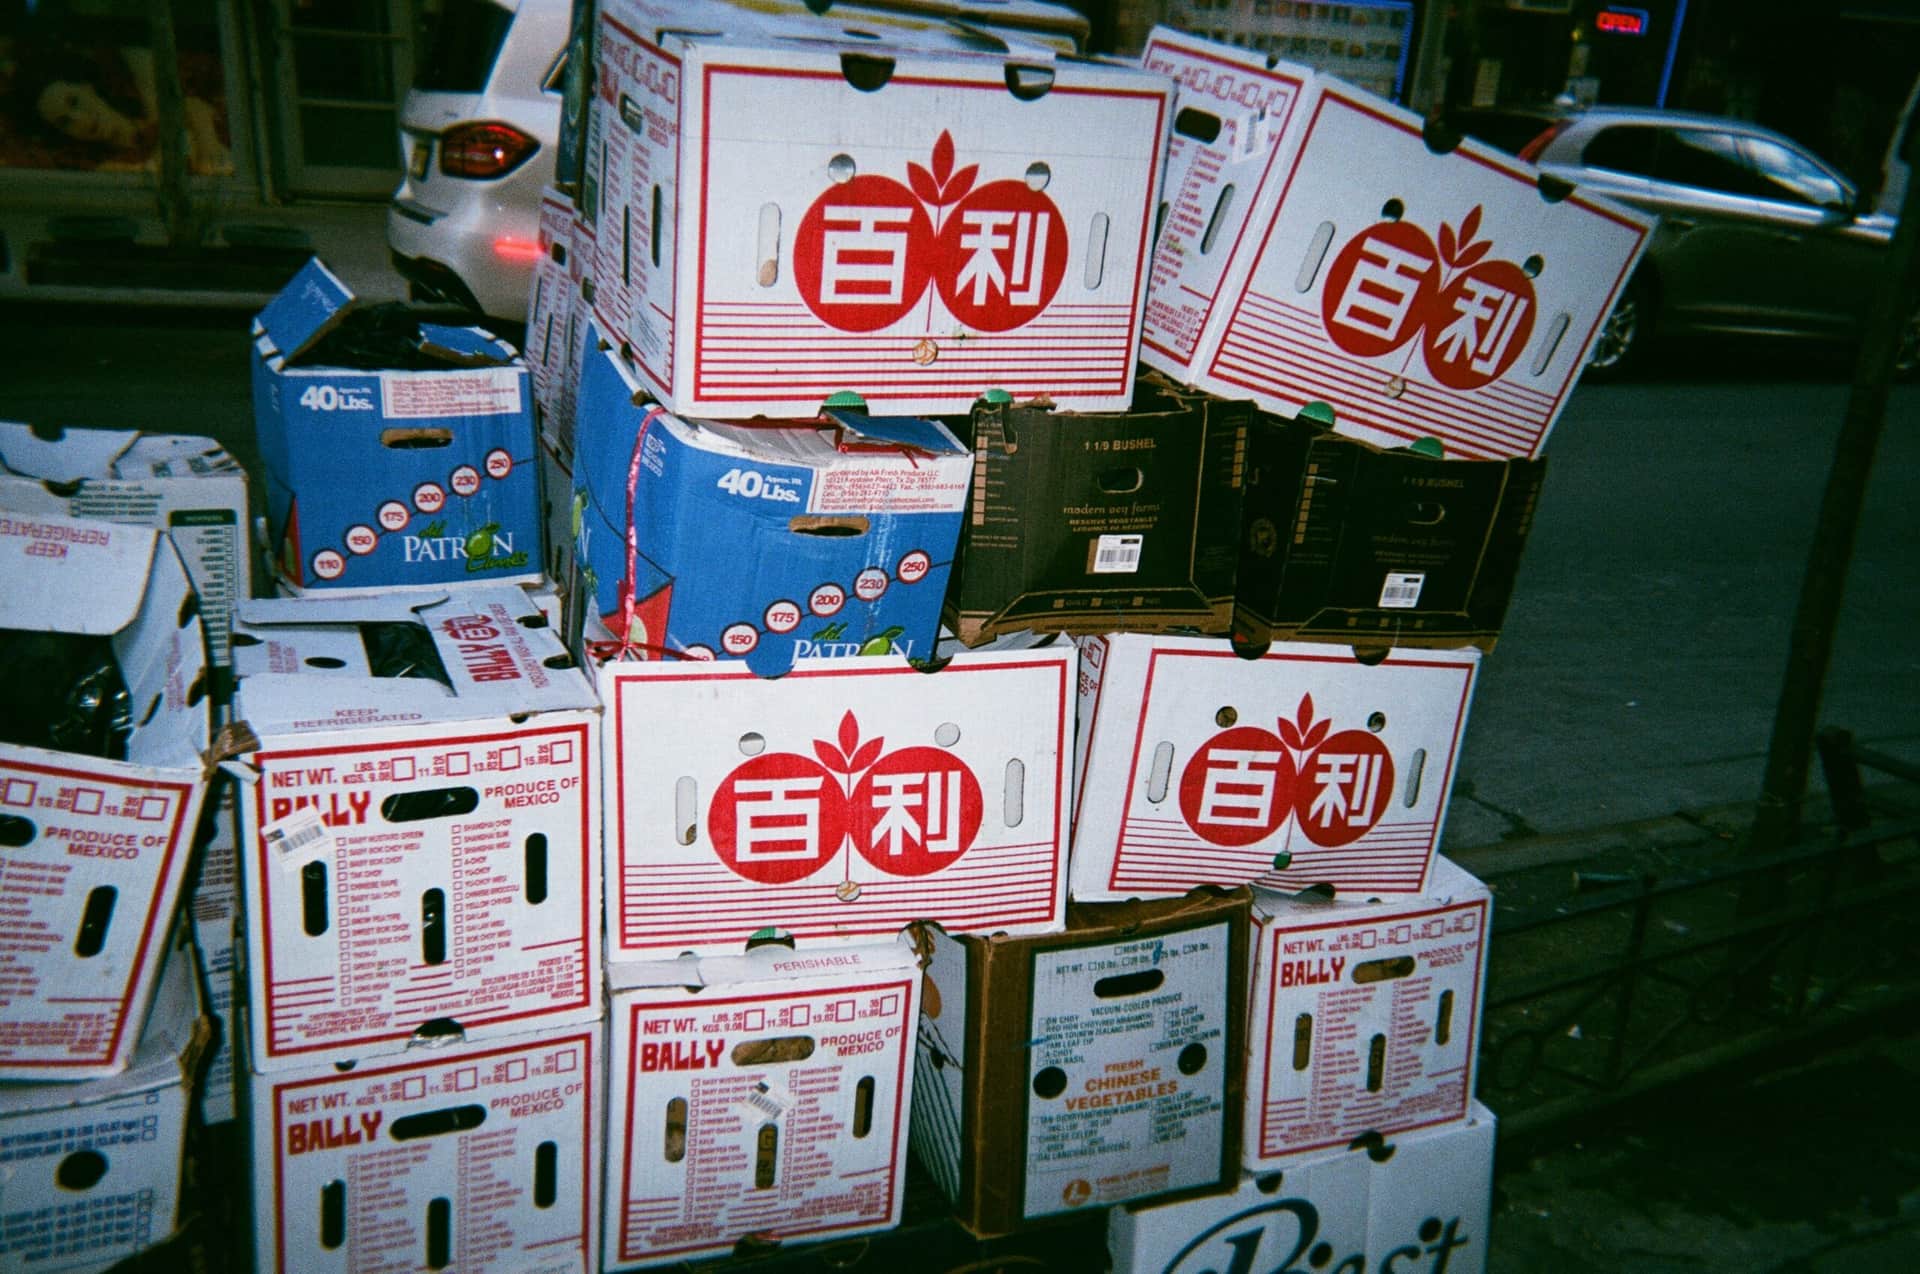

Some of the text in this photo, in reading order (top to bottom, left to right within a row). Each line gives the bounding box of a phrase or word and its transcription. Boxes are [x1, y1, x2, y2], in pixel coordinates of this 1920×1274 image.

[1596, 12, 1640, 31] OPEN
[820, 206, 1048, 307] 百利
[1348, 236, 1530, 374] 百利
[300, 385, 338, 411] 40
[338, 395, 374, 410] Lbs.
[1112, 437, 1157, 451] BUSHEL
[490, 460, 507, 469] 250
[456, 476, 476, 486] 230
[717, 468, 800, 502] 40 Lbs.
[418, 493, 440, 502] 200
[383, 512, 404, 522] 175
[1064, 504, 1105, 514] modern
[1132, 503, 1160, 516] farms
[1070, 516, 1158, 526] RESERVE VEGETABLES
[351, 536, 371, 545] 150
[24, 542, 68, 558] KEEP
[318, 560, 339, 570] 110
[903, 562, 924, 572] 250
[859, 578, 884, 590] 230
[815, 594, 840, 606] 200
[771, 612, 796, 623] 175
[728, 634, 752, 644] 150
[458, 644, 522, 682] BALLY
[294, 713, 422, 728] REFRIGERATED
[335, 708, 379, 718] KEEP
[272, 744, 548, 787] NET WT. LBS. 20 25 30 35
[342, 773, 366, 784] KGS.
[419, 767, 445, 777] 11.35
[473, 762, 497, 772] 13.62
[485, 780, 556, 798] PRODUCE
[561, 776, 580, 788] OF
[1198, 748, 1383, 828] 百利
[504, 792, 560, 808] MEXICO
[734, 770, 961, 862] 百利
[44, 826, 168, 847] PRODUCE OF
[67, 843, 140, 860] MEXICO
[1284, 939, 1324, 954] NET WT.
[773, 954, 862, 972] PERISHABLE
[1280, 940, 1478, 988] BALLY PRODUCE OF
[1430, 952, 1464, 968] MEXICO
[1056, 964, 1070, 975] NET
[1152, 992, 1182, 1006] PRODUCE
[644, 1020, 670, 1034] NET
[674, 1018, 698, 1033] WT.
[734, 1012, 744, 1020] 20
[825, 1003, 835, 1012] 30
[641, 1026, 900, 1072] BALLY PRODUCE OF
[837, 1040, 884, 1057] MEXICO
[1064, 1055, 1084, 1064] BASIL
[1104, 1059, 1144, 1073] FRESH
[1084, 1068, 1162, 1092] CHINESE
[288, 1097, 318, 1114] NET
[322, 1092, 351, 1109] WT.
[1065, 1080, 1178, 1111] VEGETABLES
[510, 1098, 564, 1118] MEXICO
[288, 1082, 582, 1155] BALLY PRODUCE OF
